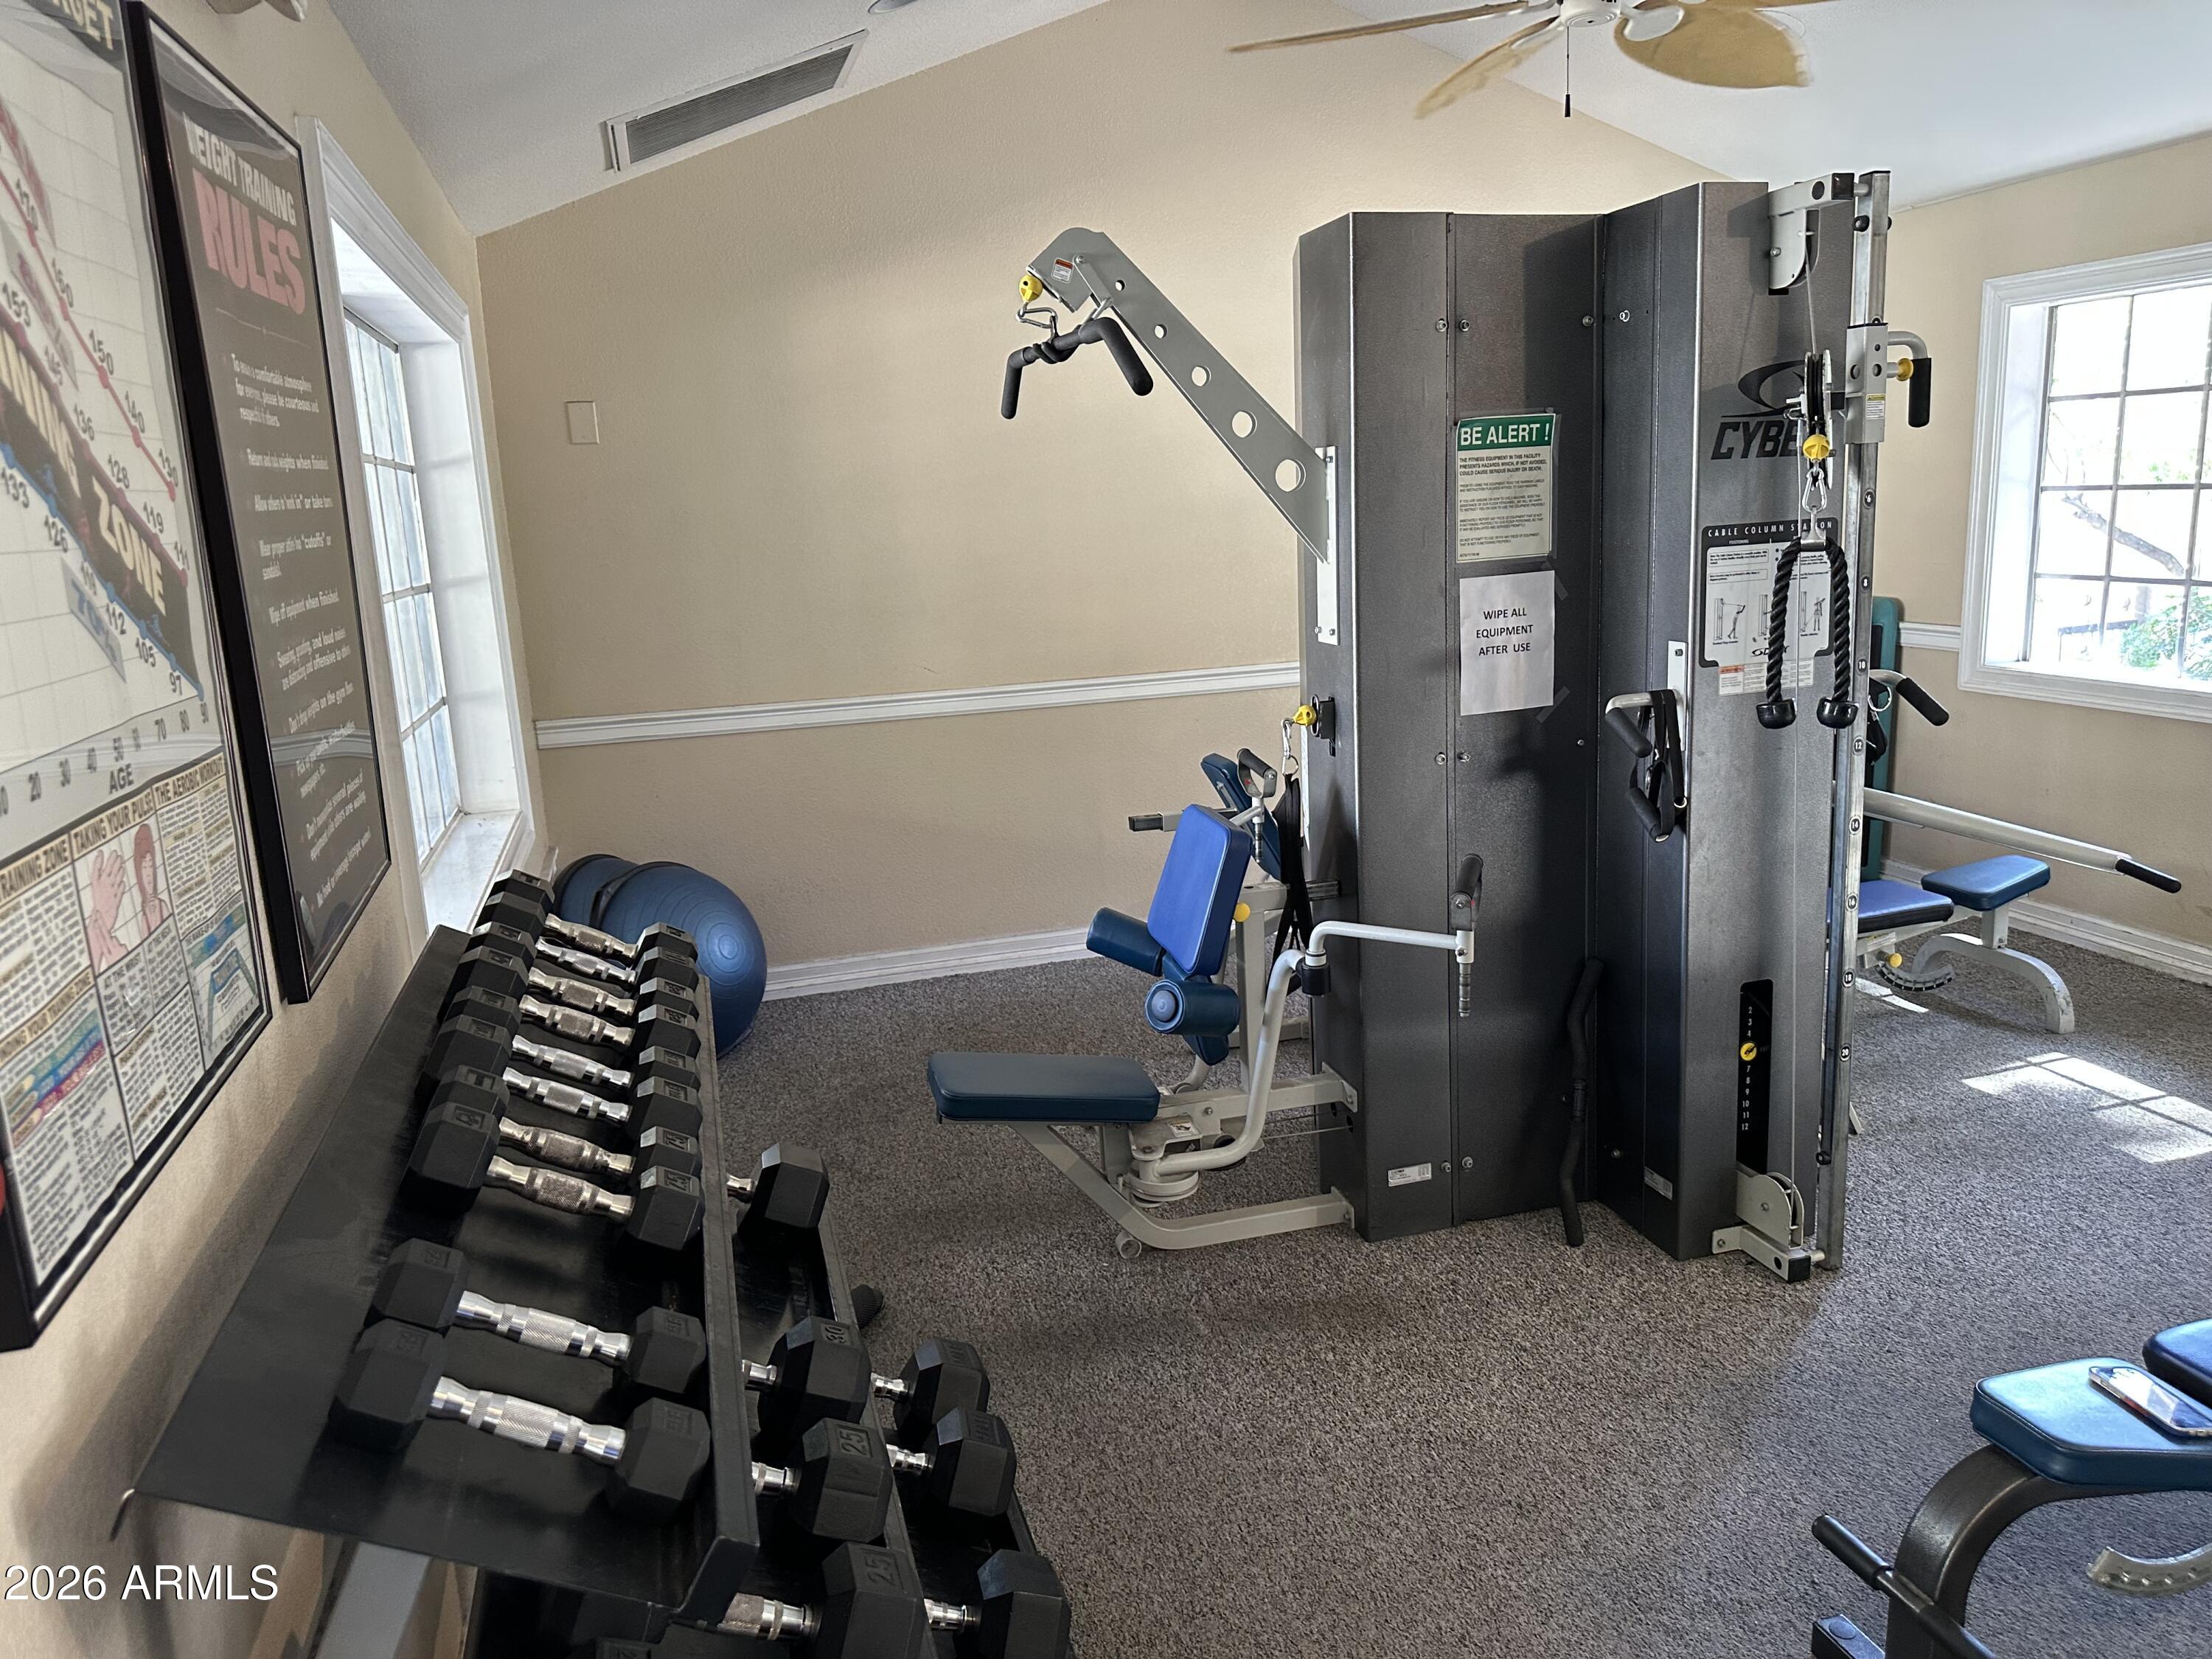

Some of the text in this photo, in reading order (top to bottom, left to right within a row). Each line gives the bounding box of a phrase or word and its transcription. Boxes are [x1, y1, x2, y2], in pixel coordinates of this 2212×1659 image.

[237, 156, 296, 226] TRAINING
[192, 167, 306, 315] RULES
[52, 257, 74, 308] 160
[88, 329, 114, 375] 150
[125, 390, 145, 434] 140
[285, 396, 310, 411] courteous
[74, 403, 95, 441] 136
[1461, 427, 1482, 445] BE
[1486, 423, 1540, 444] ALERT
[1711, 420, 1808, 459] CYBE
[108, 453, 130, 489] 128
[159, 448, 178, 487] 130
[296, 453, 311, 469] when
[1, 466, 29, 509] 133
[304, 498, 311, 509] or
[310, 493, 324, 509] take
[142, 501, 164, 534] 119
[44, 515, 69, 553] 126
[1708, 524, 1784, 538] CABLE COLUMN
[91, 475, 167, 617] ZONE
[1863, 579, 1868, 587] 8
[305, 594, 320, 610] when
[1484, 608, 1527, 619] WIPE ALL
[105, 602, 126, 635] 112
[311, 628, 335, 650] and loud
[1476, 625, 1534, 639] EQUIPMENT
[135, 637, 156, 668] 105
[313, 649, 336, 670] offensive
[1478, 642, 1531, 656] AFTER USE
[1858, 661, 1865, 669] 10
[169, 672, 184, 695] 97
[319, 696, 327, 709] on
[327, 689, 336, 706] the
[335, 687, 347, 705] gym
[154, 717, 167, 742] 70
[1854, 741, 1862, 750] 12
[28, 772, 41, 802] 20
[108, 763, 134, 794] AGE
[155, 782, 172, 806] THE
[74, 817, 108, 854] TAKING
[107, 804, 131, 835] YOUR
[1851, 821, 1859, 830] 14
[43, 838, 69, 874] ZONE
[1848, 898, 1856, 906] 16
[1845, 973, 1852, 981] 18
[1841, 1048, 1849, 1057] 20
[825, 1326, 846, 1343] 30
[839, 1430, 868, 1455] 25
[864, 1556, 895, 1583] 25
